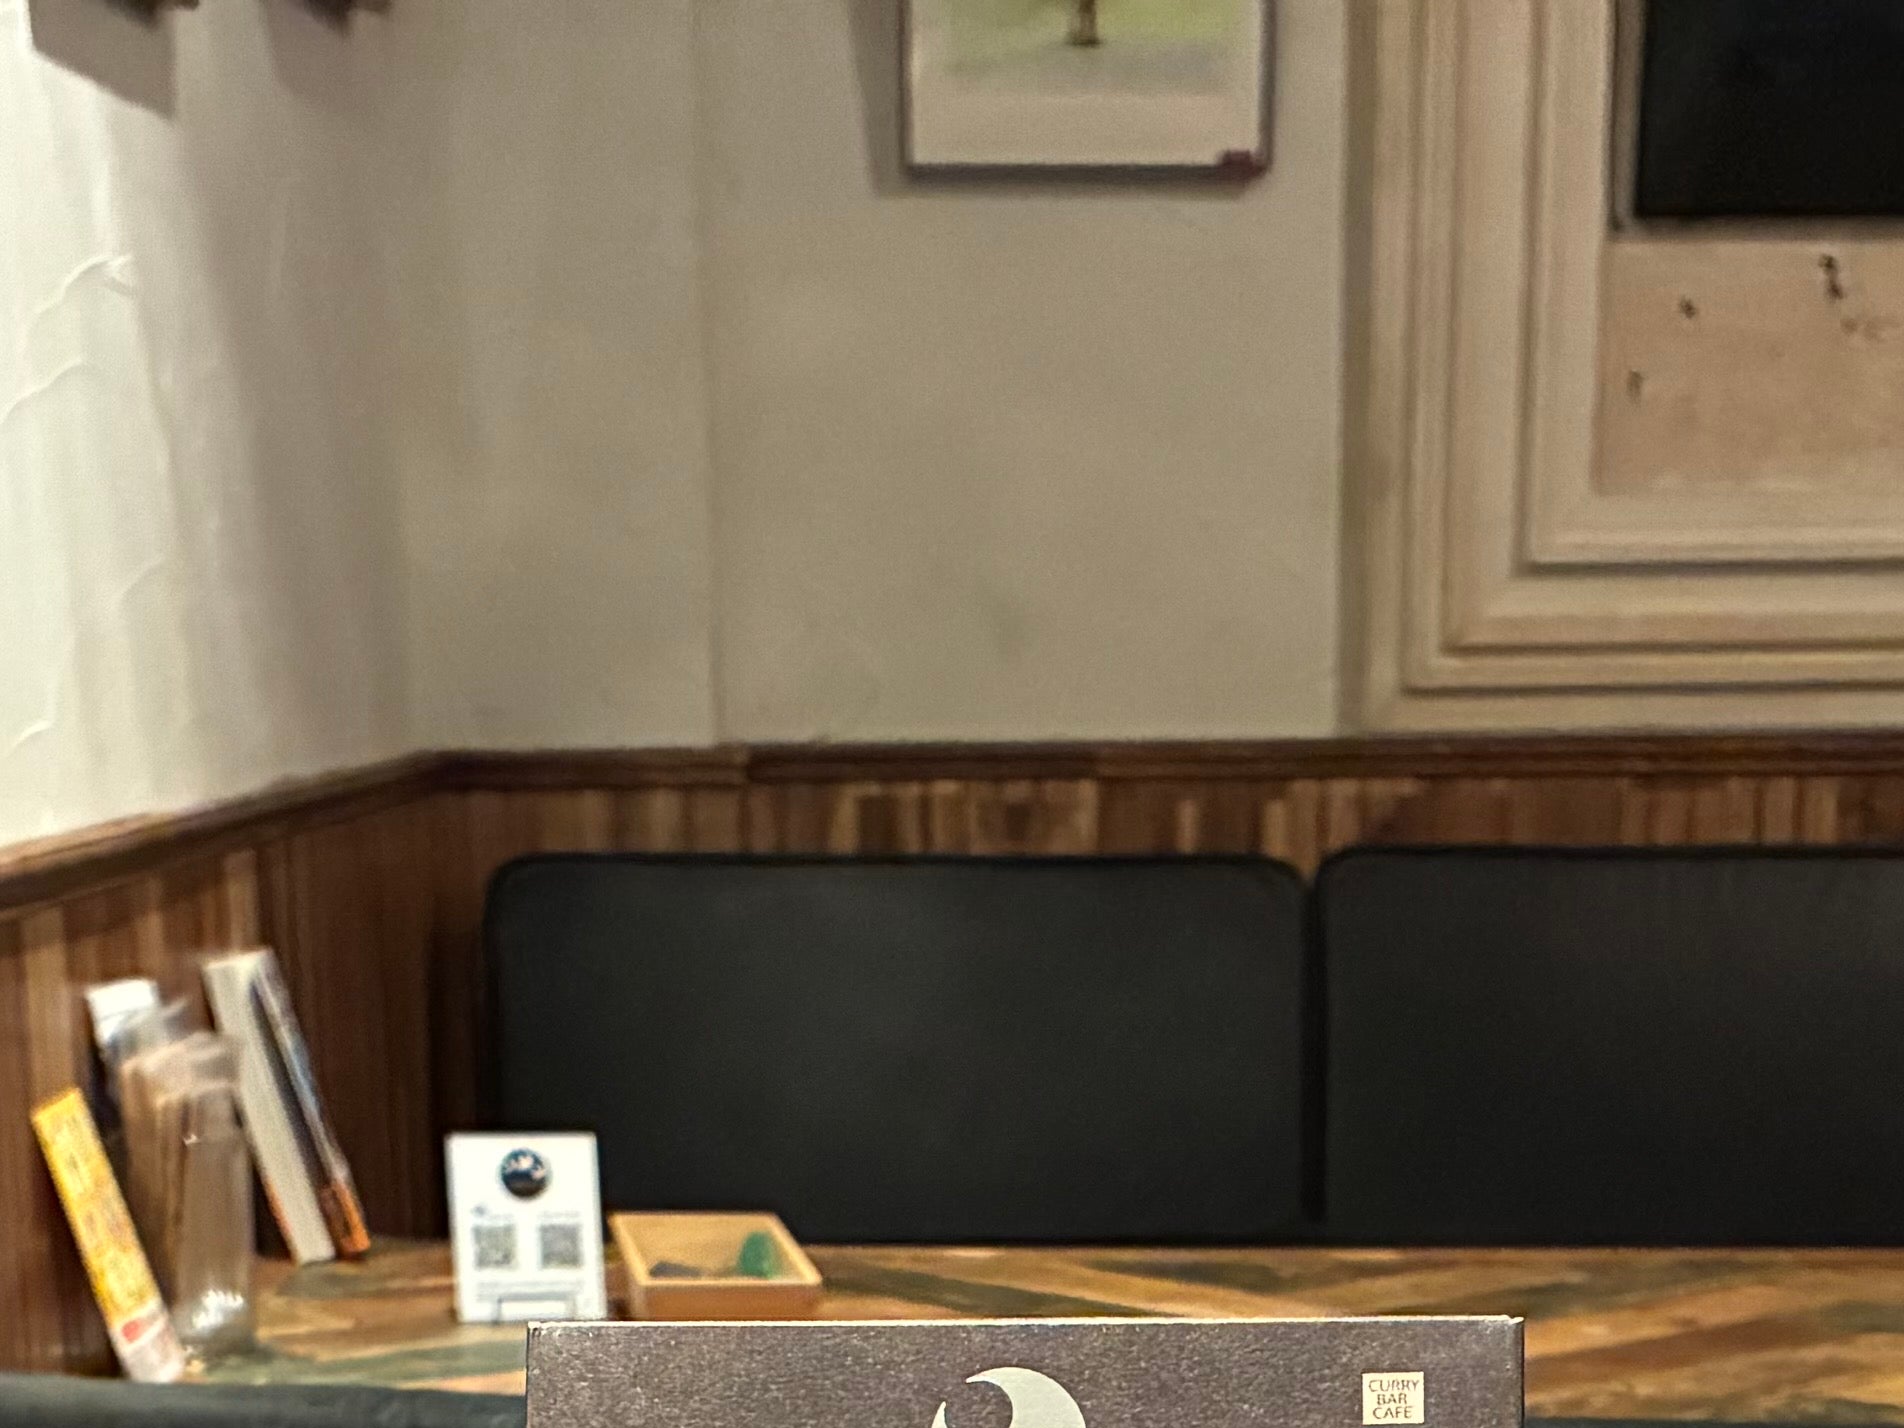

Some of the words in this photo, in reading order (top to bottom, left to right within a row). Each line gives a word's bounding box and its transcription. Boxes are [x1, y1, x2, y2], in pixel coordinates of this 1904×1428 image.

[1368, 1379, 1420, 1392] CURRY
[1377, 1392, 1408, 1405] BAR
[1372, 1405, 1414, 1420] CAFE
